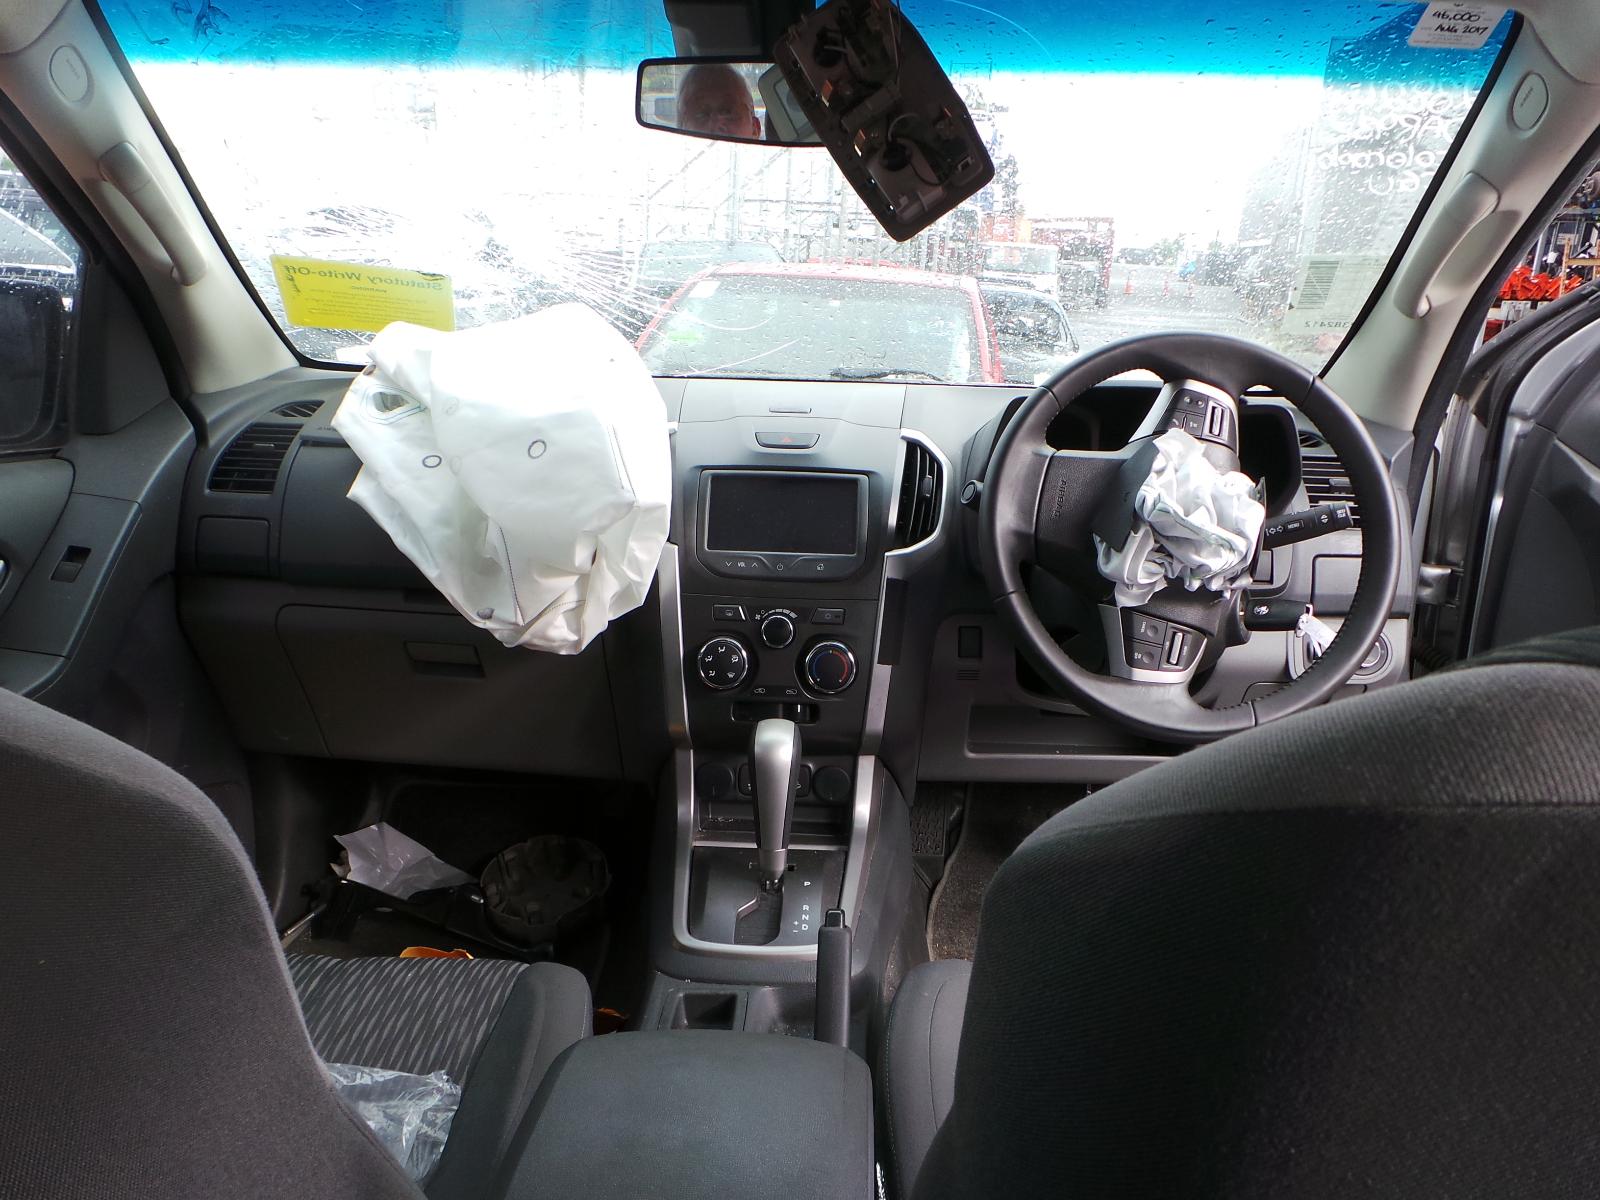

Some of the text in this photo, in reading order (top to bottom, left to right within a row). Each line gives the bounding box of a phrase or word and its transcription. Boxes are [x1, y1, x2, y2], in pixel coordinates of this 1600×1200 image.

[1432, 10, 1480, 22] 46,000
[1462, 25, 1488, 35] 2017
[1050, 480, 1067, 520] AIRBAG
